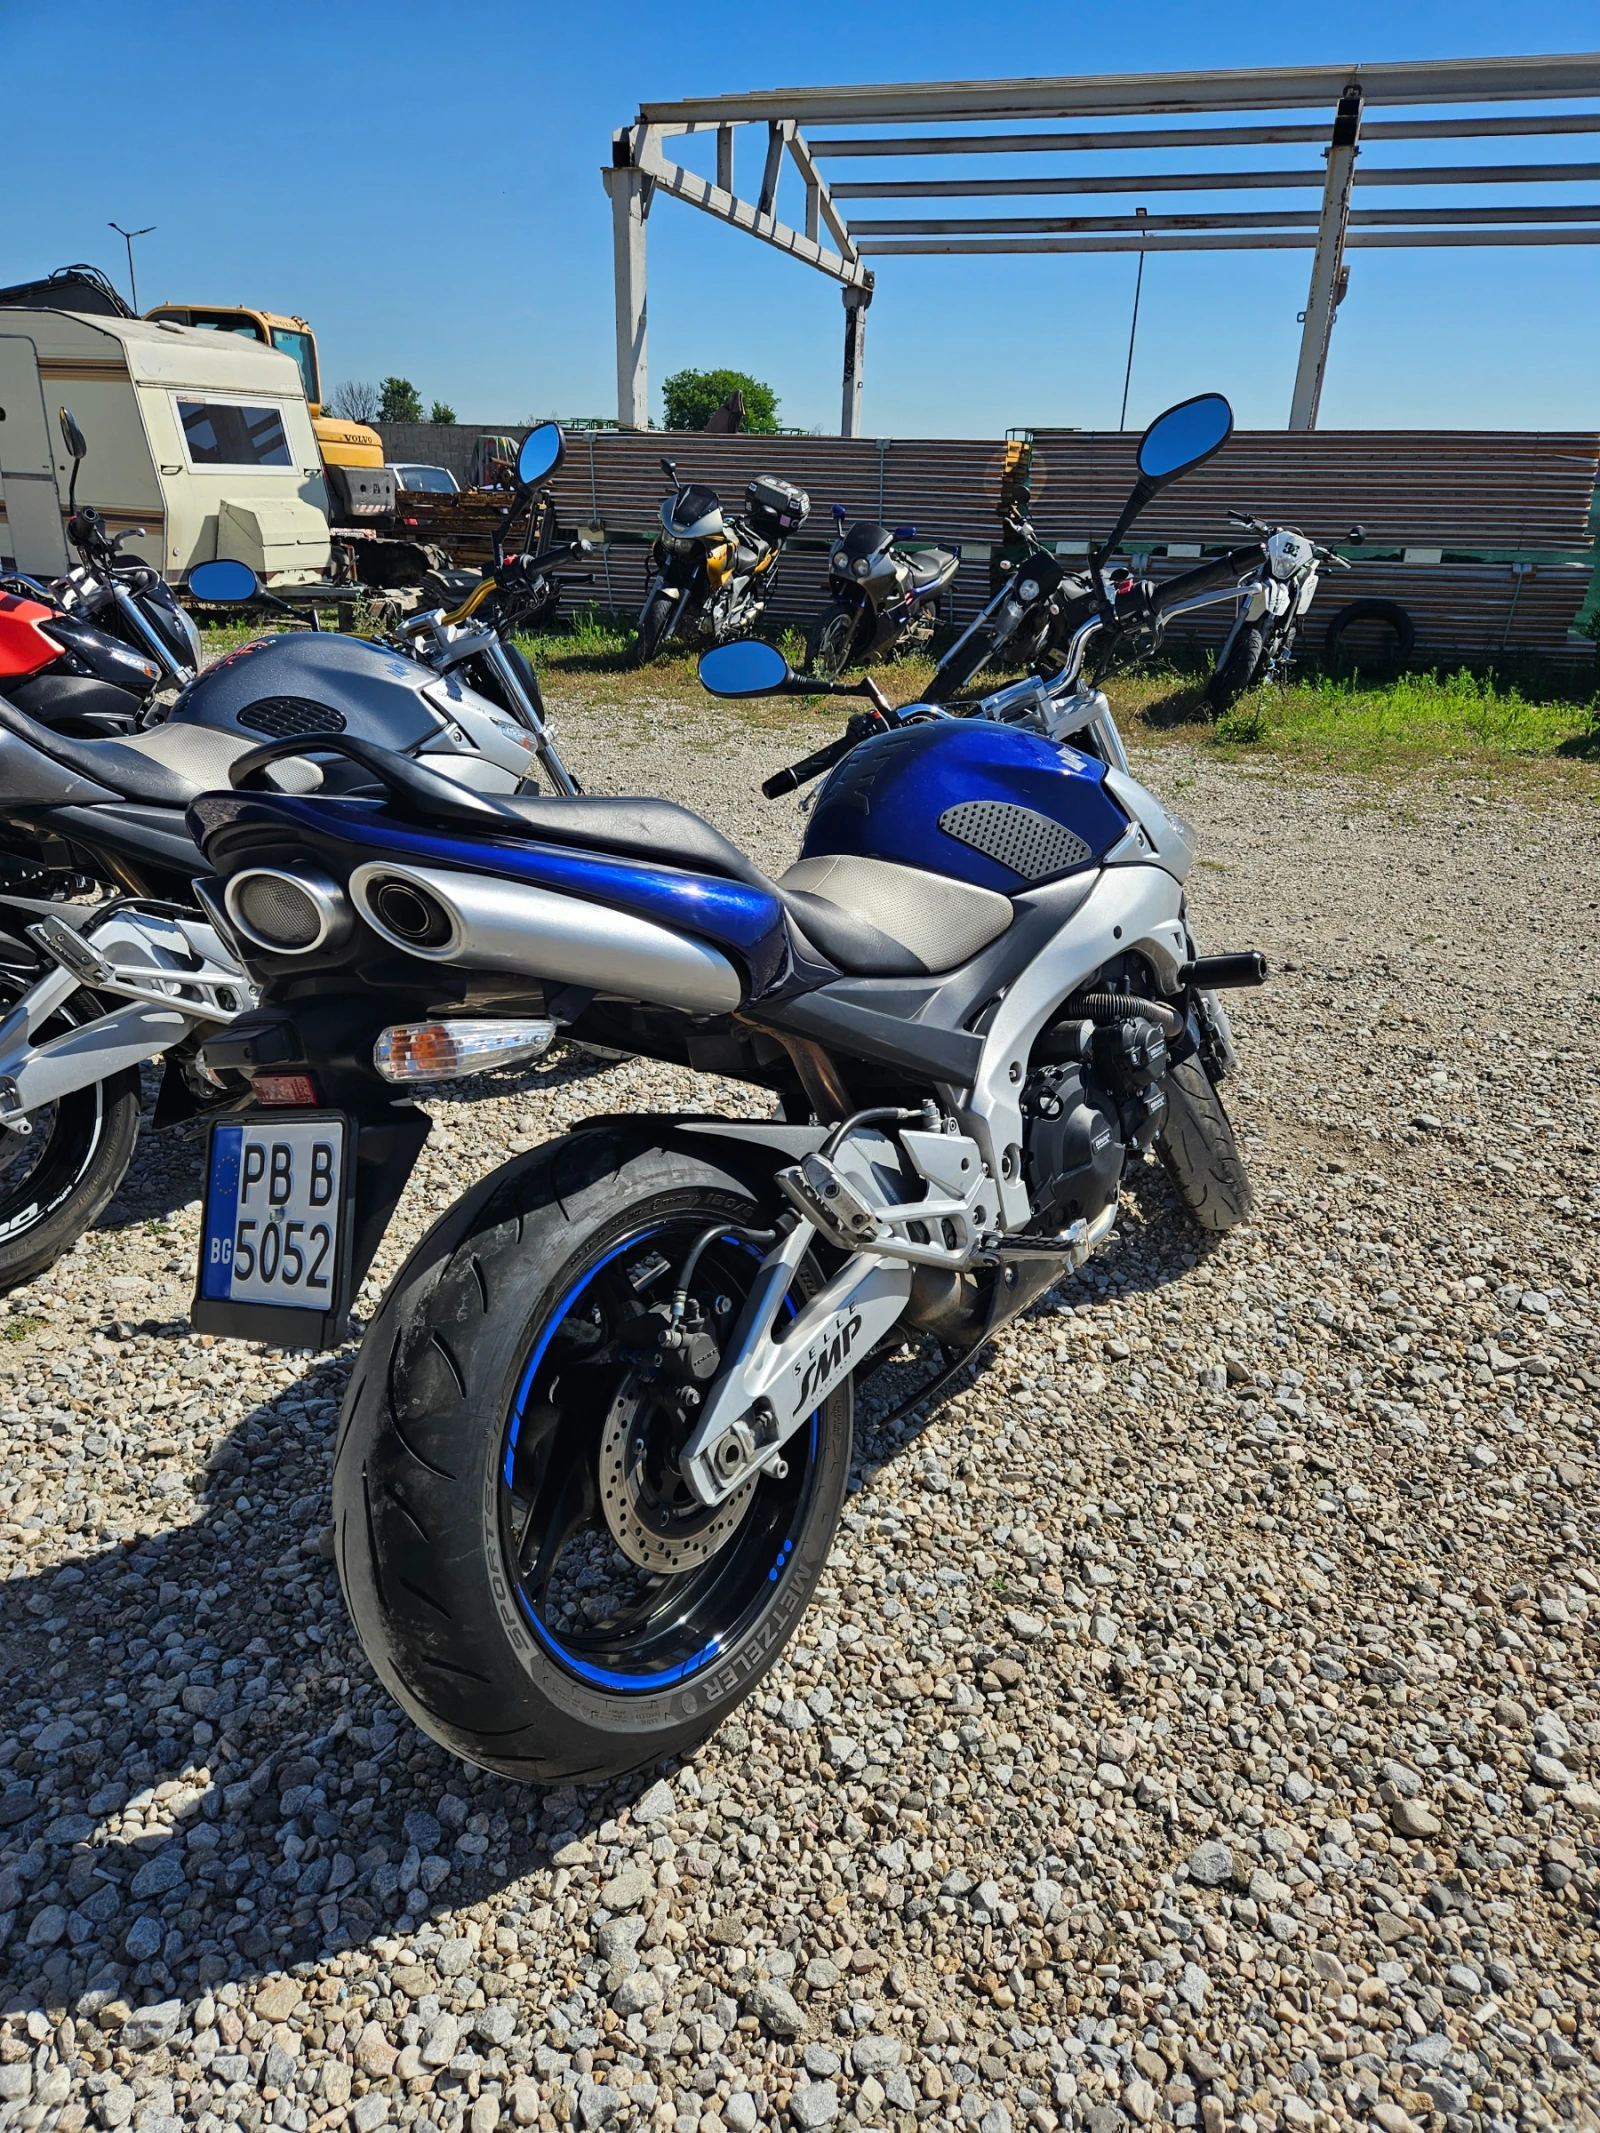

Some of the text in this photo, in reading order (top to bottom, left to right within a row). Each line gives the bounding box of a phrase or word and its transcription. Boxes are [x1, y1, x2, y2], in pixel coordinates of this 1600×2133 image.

[343, 434, 373, 444] VOLVO
[240, 1143, 333, 1206] PB B
[210, 1237, 232, 1265] BG
[233, 1220, 331, 1288] 5052
[792, 1314, 863, 1418] SMP
[794, 1300, 857, 1377] SELLE
[702, 1565, 813, 1702] METZELER
